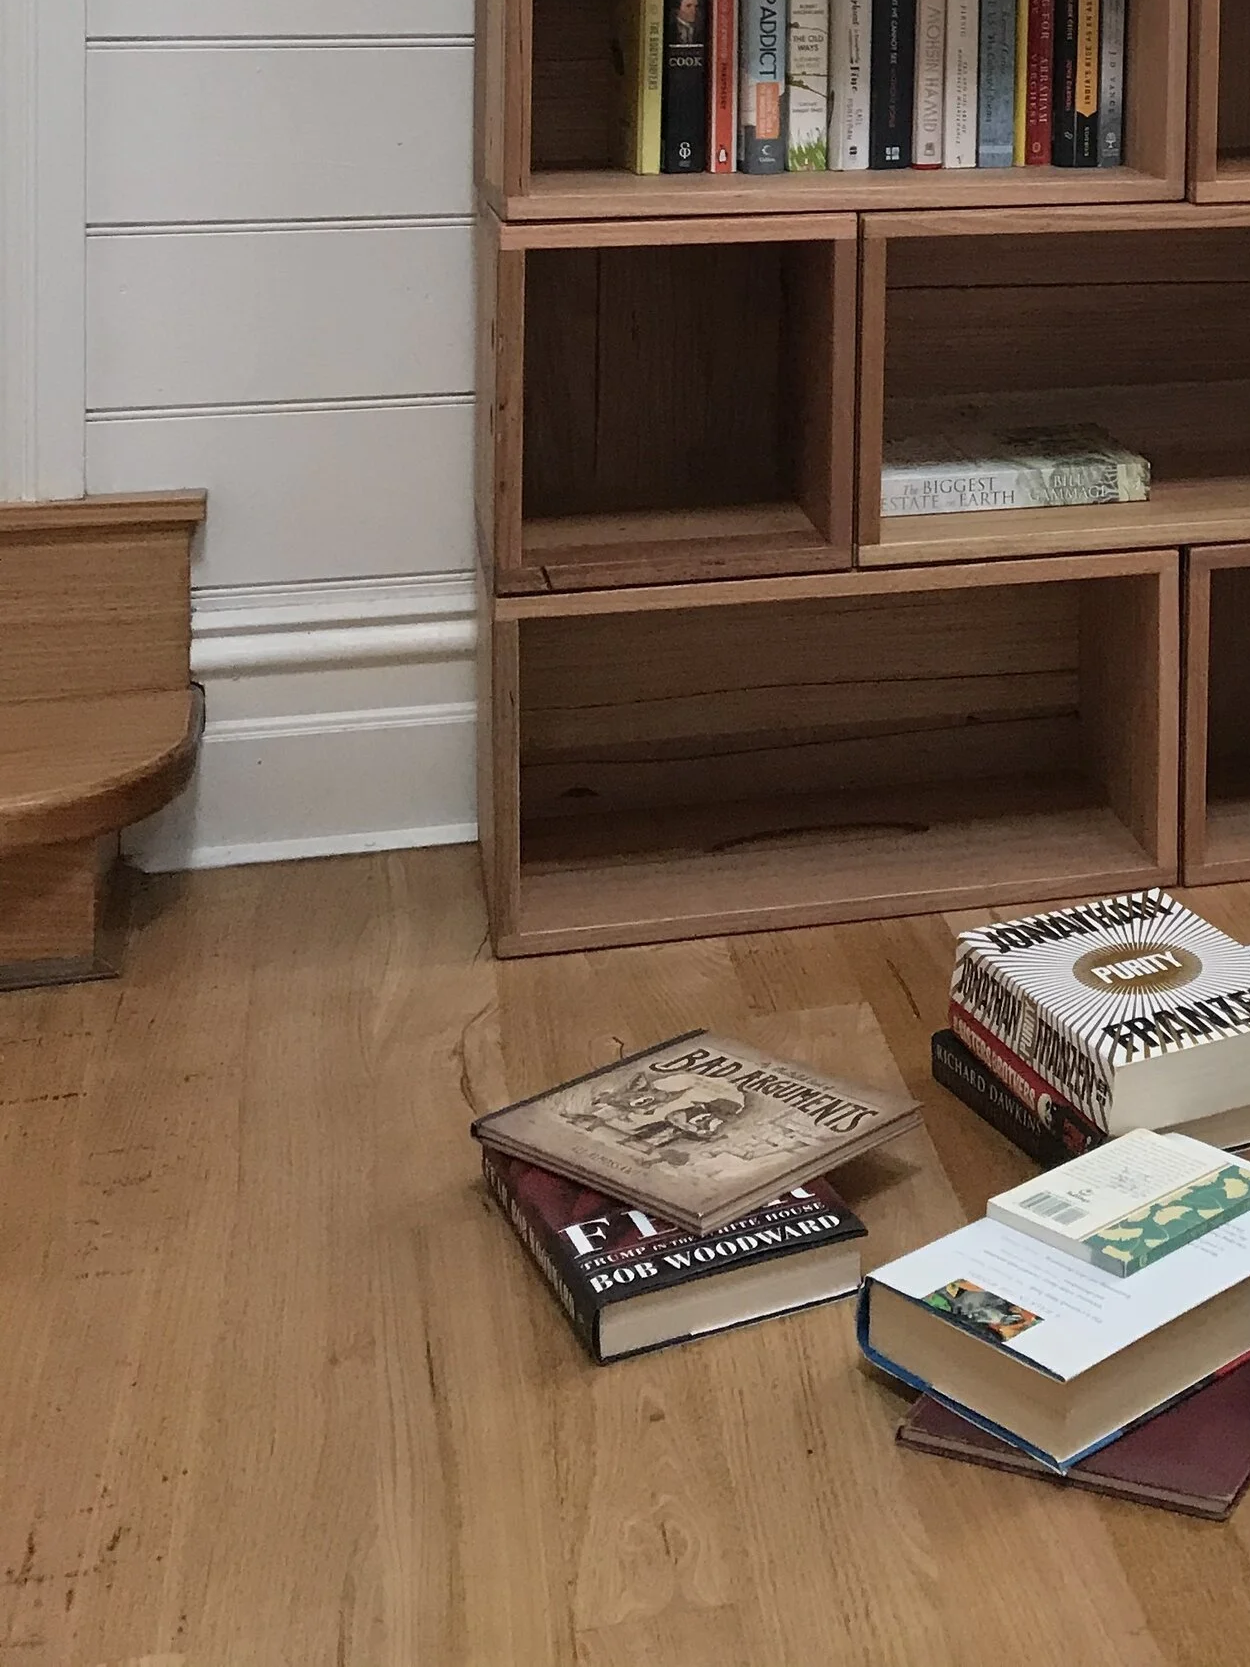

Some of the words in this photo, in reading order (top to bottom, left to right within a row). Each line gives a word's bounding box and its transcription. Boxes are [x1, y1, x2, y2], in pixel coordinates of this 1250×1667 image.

[759, 6, 778, 80] ADDICT
[797, 44, 819, 52] WAYS
[807, 34, 824, 42] OLD
[924, 5, 942, 72] MOHSIN
[1039, 13, 1050, 39] FOR
[669, 57, 703, 67] COOK
[1038, 56, 1049, 123] ABRAHAM
[923, 77, 940, 133] HAMID
[903, 484, 920, 496] The
[923, 477, 997, 494] BIGGEST
[959, 490, 1015, 507] EARTH
[1028, 485, 1108, 502] GAMMAGE
[1053, 474, 1084, 488] BILL
[984, 897, 1175, 954] JONATHAN
[1090, 950, 1183, 984] PURITY
[1018, 998, 1037, 1056] PURITY
[649, 1047, 743, 1078] BAD
[729, 1069, 880, 1133] ARGUMENTS
[935, 1044, 986, 1093] RICHARD
[989, 1083, 1041, 1134] DAWKINS
[580, 1246, 646, 1271] TRUMP
[652, 1242, 668, 1252] IN
[765, 1200, 827, 1223] HOUSE
[589, 1259, 659, 1295] BOB
[663, 1213, 841, 1271] WOODWARD
